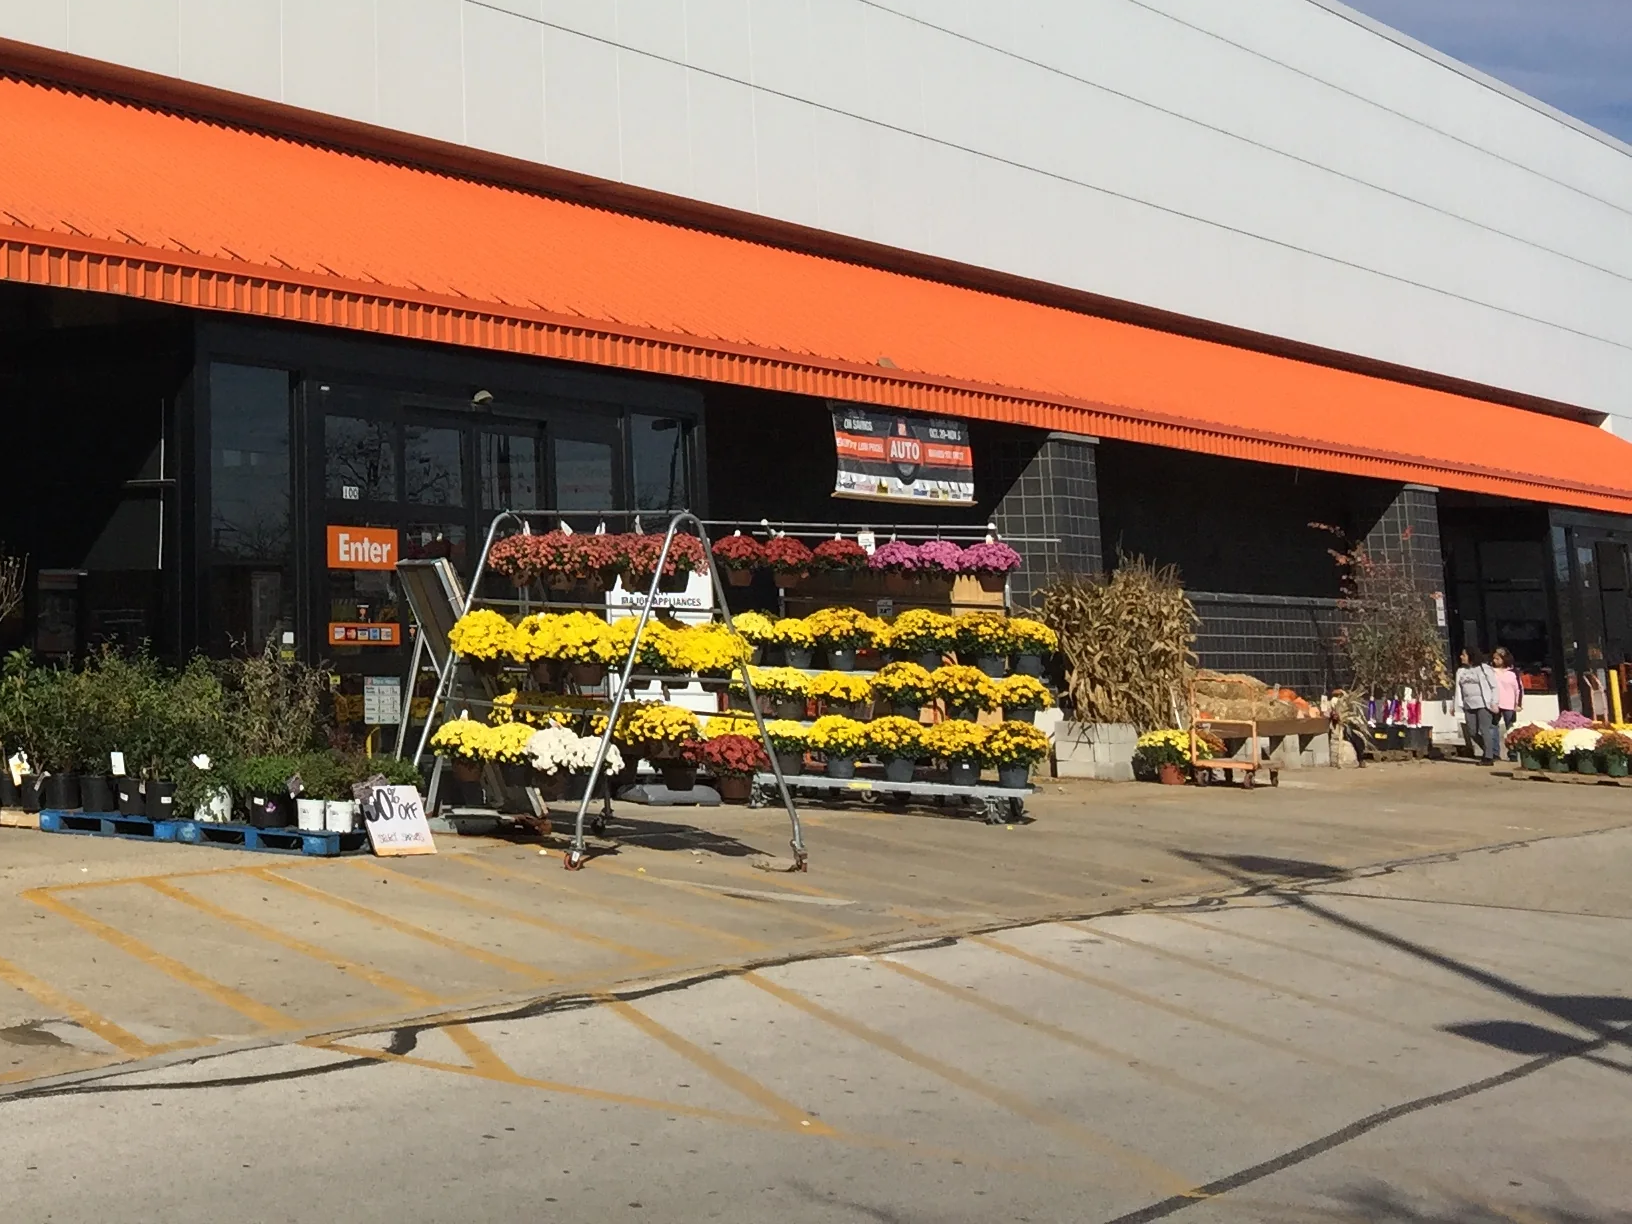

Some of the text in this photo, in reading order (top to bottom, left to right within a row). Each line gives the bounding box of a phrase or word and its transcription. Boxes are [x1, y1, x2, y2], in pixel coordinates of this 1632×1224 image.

[890, 440, 920, 460] AUTO
[344, 487, 358, 499] 100
[339, 533, 391, 563] Enter
[652, 596, 702, 606] APPLIANCES
[398, 802, 418, 820] OFF
